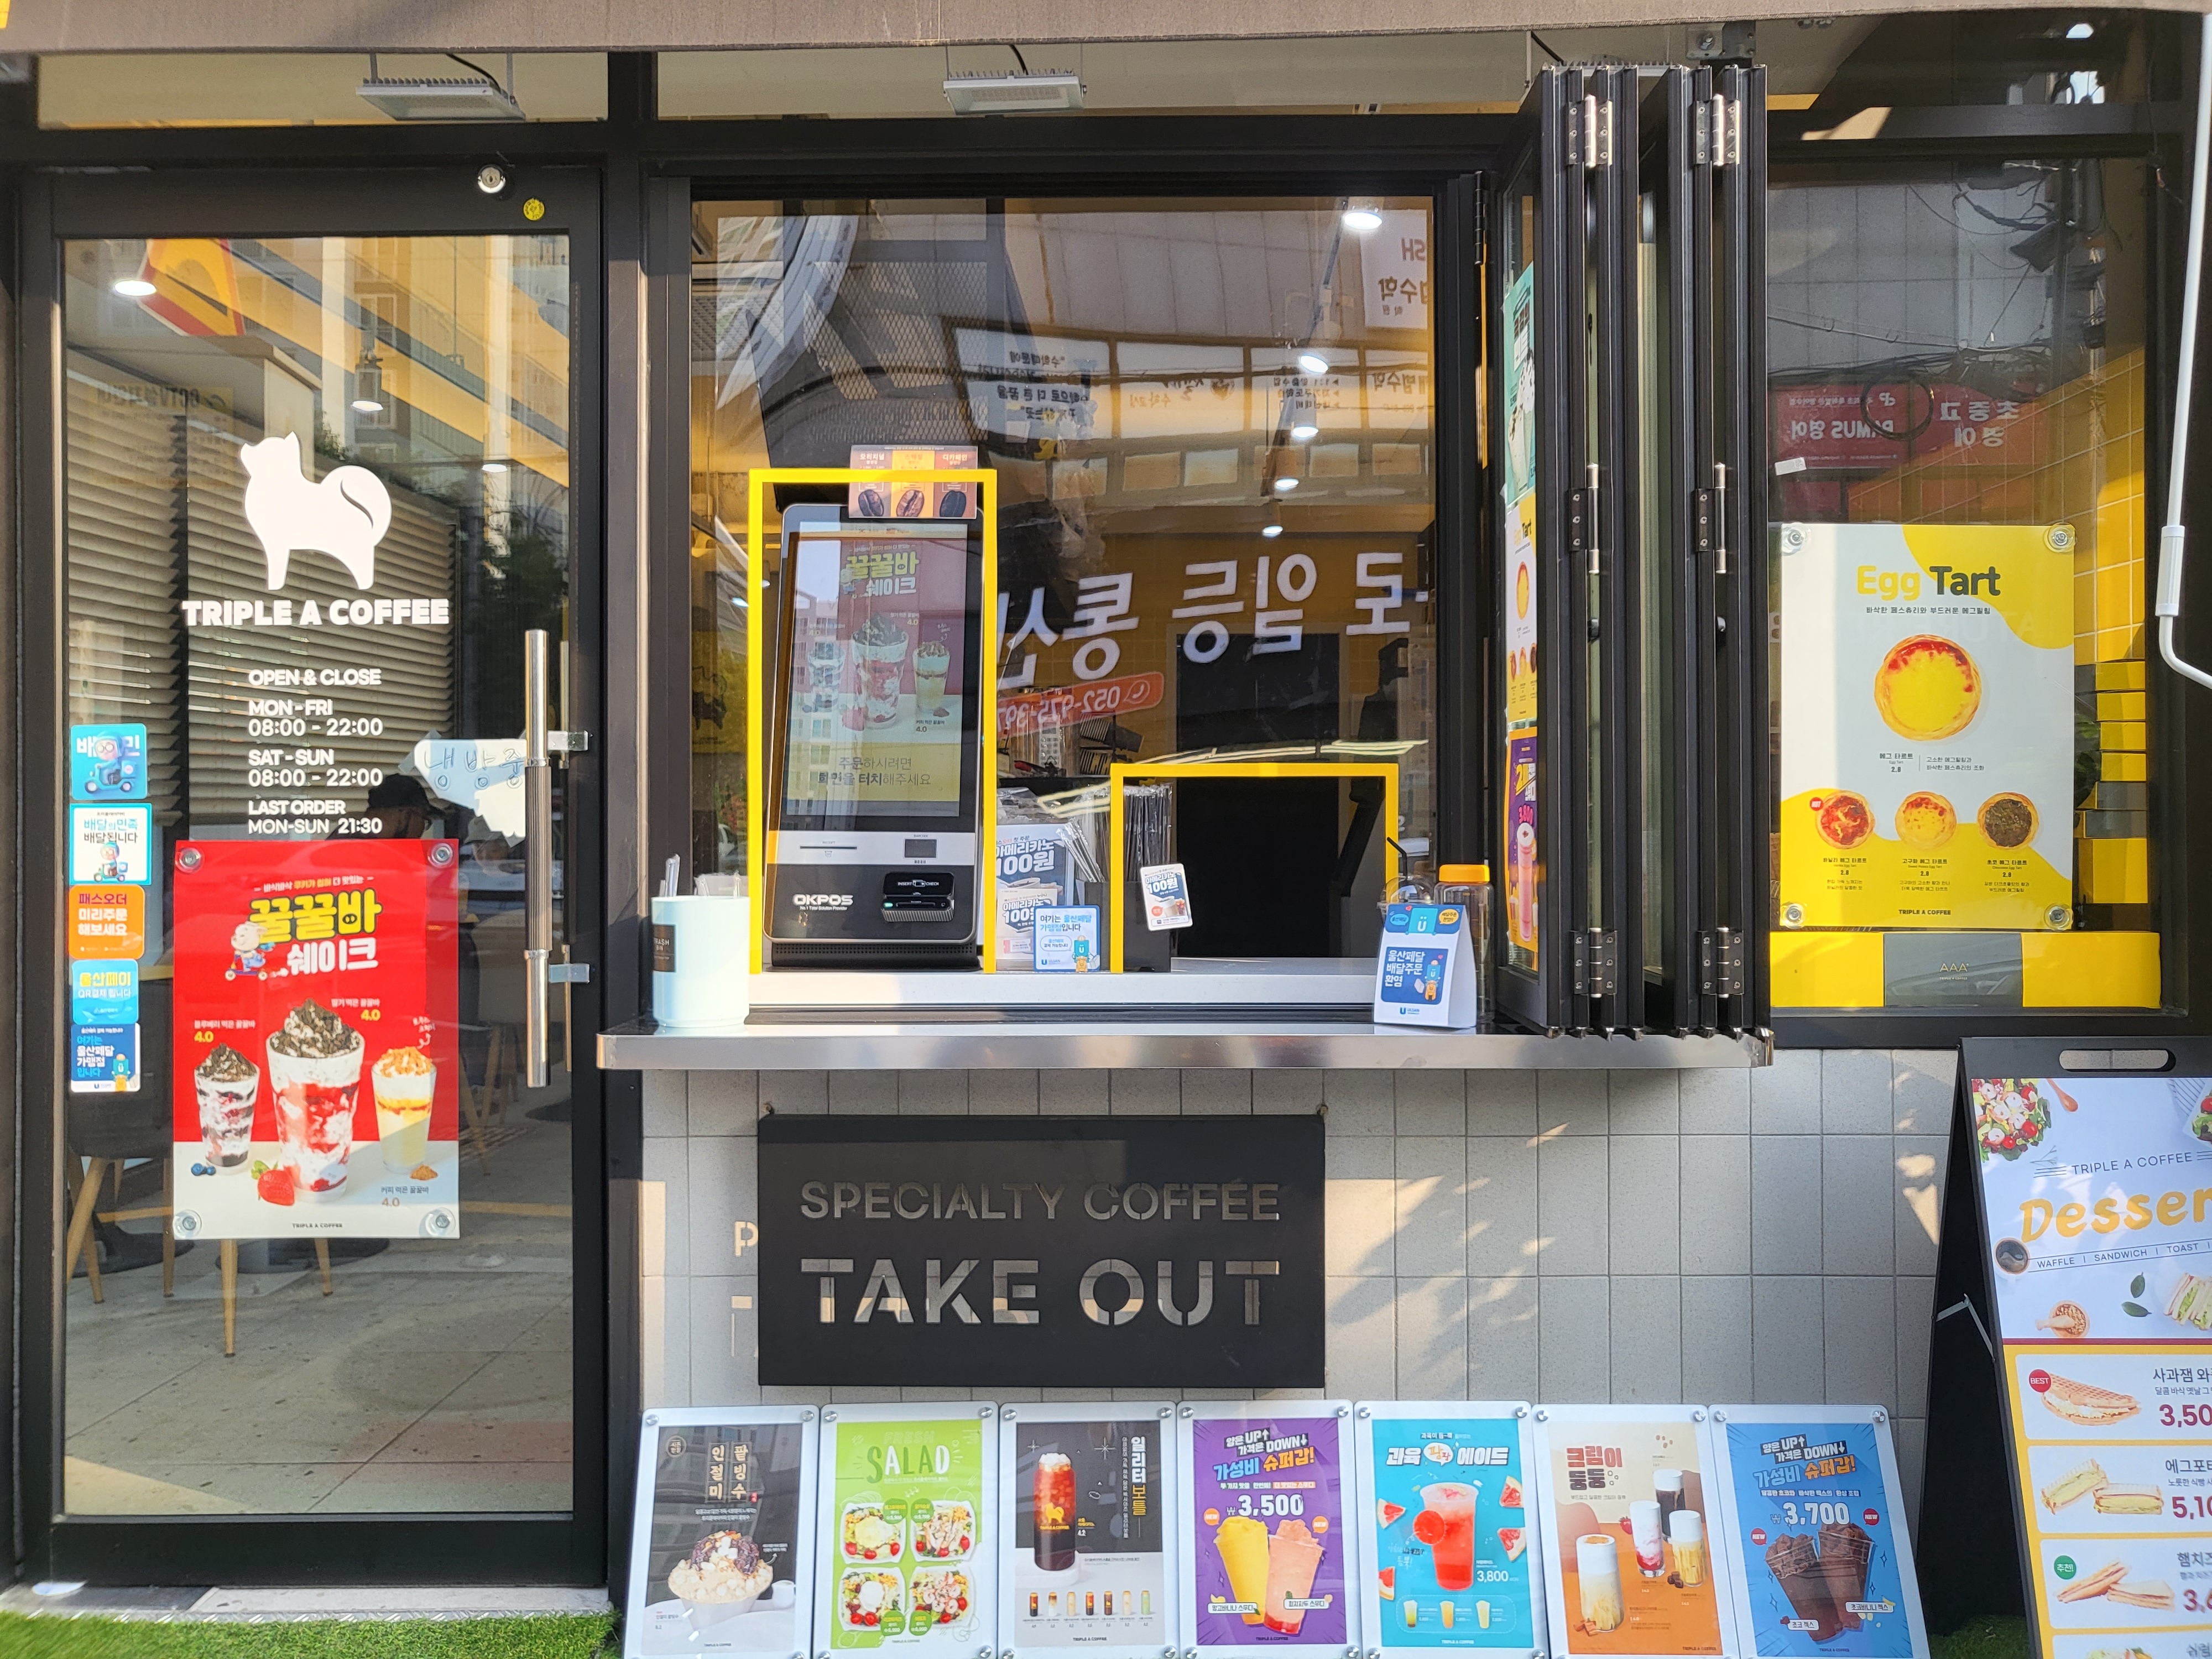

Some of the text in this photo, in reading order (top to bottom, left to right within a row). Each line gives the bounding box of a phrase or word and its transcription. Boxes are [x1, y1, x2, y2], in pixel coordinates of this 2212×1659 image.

[846, 551, 920, 581] 꿀꿀바
[1856, 565, 2001, 601] Egg Tart
[182, 599, 450, 626] TRIPLE A COFFEE
[248, 669, 382, 686] OPEN & CLOSE
[248, 719, 306, 737] 08:00
[326, 718, 383, 737] 22:00
[838, 757, 912, 770] 주문하시려면
[248, 769, 306, 787] 08:00
[326, 768, 383, 787] 22:00
[858, 773, 932, 786] 터치해주세요
[248, 800, 346, 816] LAST ORDER
[84, 818, 138, 831] 배달의민족
[248, 817, 383, 834] MON-SUN 21:30
[84, 832, 138, 844] 배달됩니다
[995, 838, 1055, 858] 아메리카노
[995, 849, 1055, 878] 100원
[1146, 877, 1178, 894] 100원
[79, 893, 127, 906] 패스오더
[791, 893, 854, 907] OKPOS
[1003, 899, 1045, 911] 아메리카노
[79, 908, 128, 922] 미리주문
[248, 887, 383, 945] 꿀꿀바
[1040, 915, 1062, 924] 여기는
[78, 924, 128, 937] 해보세요
[1040, 924, 1081, 932] 가맹점입니다
[286, 937, 379, 975] 쉐이크
[1387, 950, 1426, 963] 울산페달
[1386, 962, 1423, 975] 배달주문
[1939, 963, 1968, 972] AAA
[1384, 974, 1404, 988] 환영
[361, 1009, 381, 1021] 4.0
[77, 1035, 103, 1046] 여기는
[194, 1031, 214, 1043] 4.0
[77, 1056, 106, 1068] 가맹점
[77, 1067, 101, 1078] 입니다
[2071, 1151, 2193, 1175] TRIPLE A COFFEE
[380, 1186, 394, 1194] 커피
[382, 1197, 400, 1207] 4.0
[800, 1181, 1281, 1221] SPECIALTY COFFEE
[2037, 1243, 2199, 1269] WAFFLE SANDWICH TOAST
[800, 1258, 1281, 1327] TAKE OUT
[2152, 1367, 2193, 1383] 사과잼
[2154, 1386, 2169, 1395] 달콤
[2171, 1386, 2185, 1395] 바삭
[2186, 1386, 2201, 1395] 옛날
[1225, 1430, 1262, 1448] 양은 UP
[1238, 1435, 1300, 1456] 가격은 DOWN
[1762, 1437, 1798, 1454] 양은 UP
[1131, 1436, 1147, 1484] 일리터
[1386, 1447, 1422, 1465] 과육
[1457, 1447, 1509, 1465] 에이드
[1566, 1445, 1623, 1468] 크림이
[1775, 1442, 1839, 1462] 가격은 DOWN
[731, 1444, 749, 1500] 팥빙수
[866, 1444, 950, 1484] SALAD
[1213, 1446, 1315, 1481] 가성비 슈퍼갑!
[1754, 1454, 1856, 1489] 가성비 슈퍼갑!
[708, 1445, 725, 1501] 인절미
[1569, 1468, 1605, 1491] 둥둥
[2168, 1478, 2205, 1487] 노릇한 식빵
[1238, 1494, 1304, 1517] 3,500
[1783, 1502, 1850, 1526] 3,700
[1477, 1570, 1509, 1583] 3,800
[2056, 1563, 2074, 1573] 추천!
